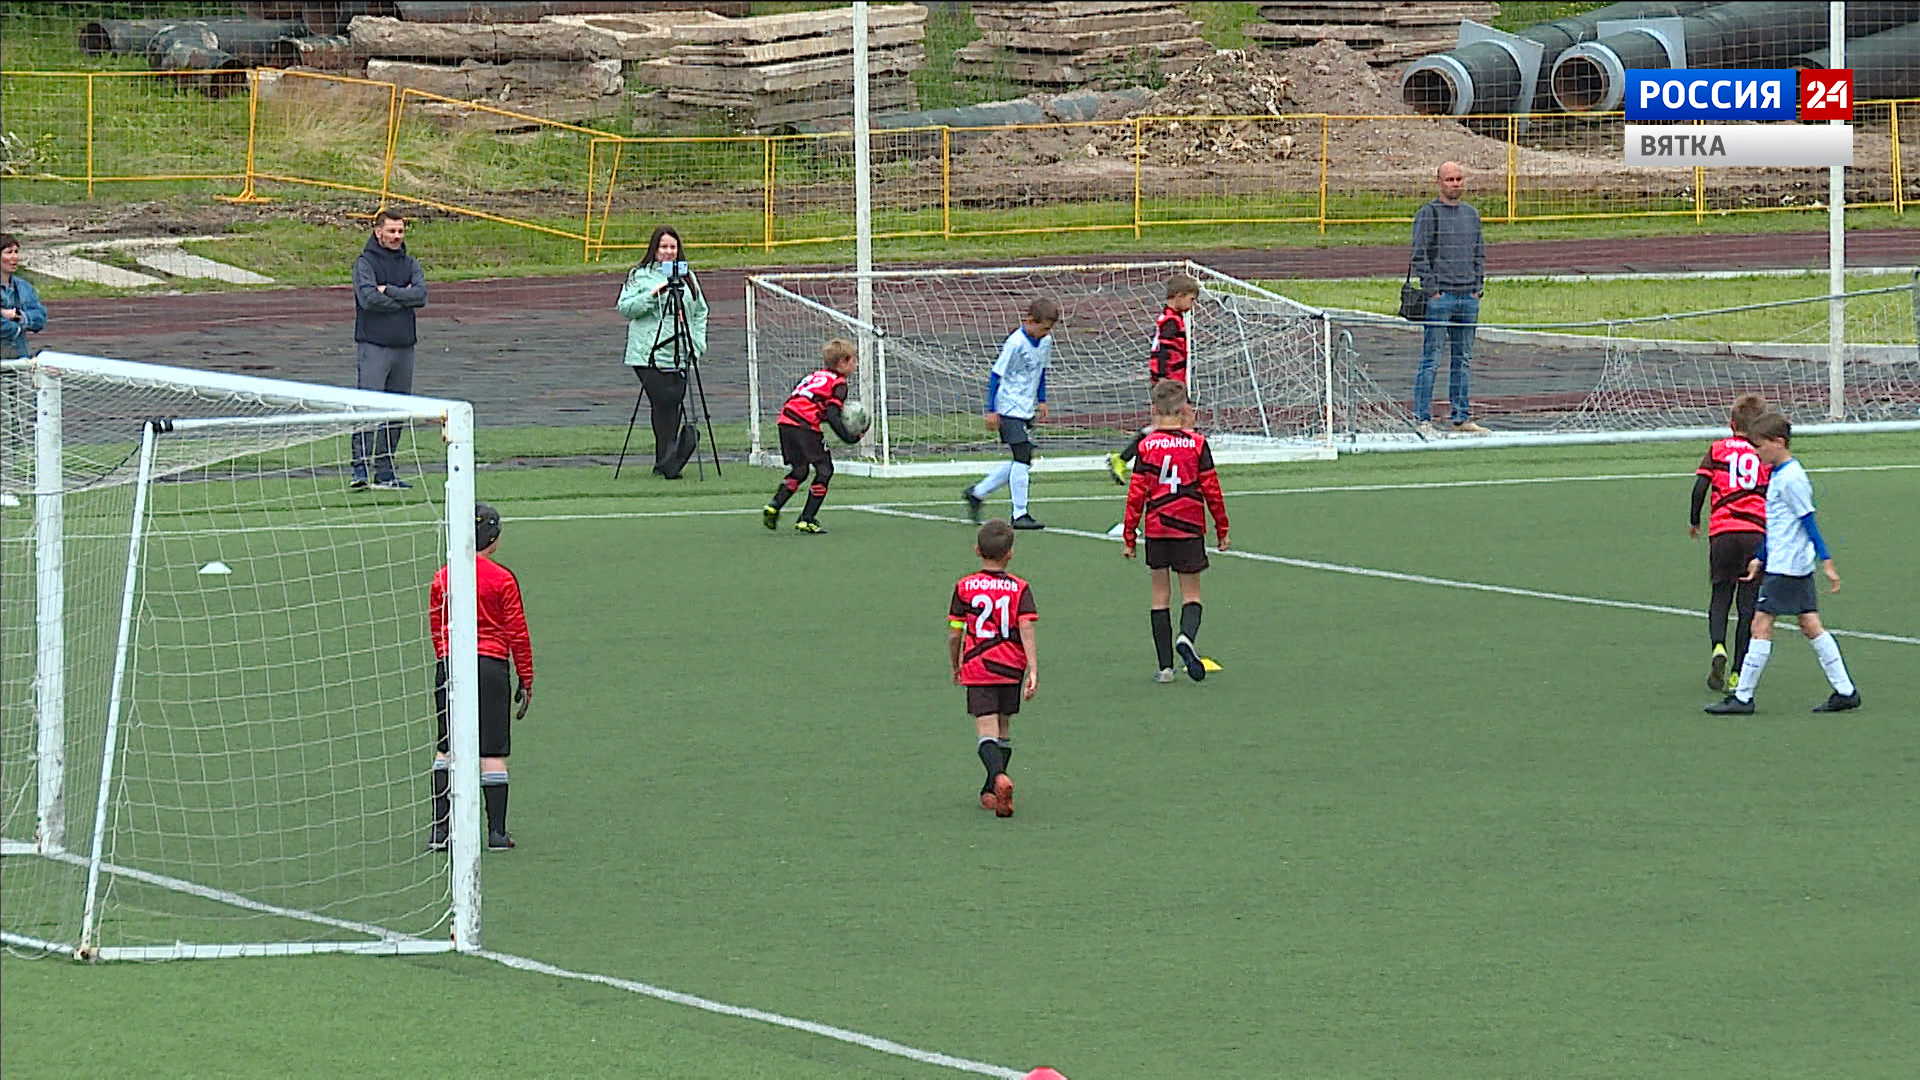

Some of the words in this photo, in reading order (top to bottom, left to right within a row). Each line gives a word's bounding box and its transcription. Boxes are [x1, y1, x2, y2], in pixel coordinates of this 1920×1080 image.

[1158, 454, 1182, 494] 4
[1725, 451, 1760, 490] 19
[971, 594, 1011, 638] 21
